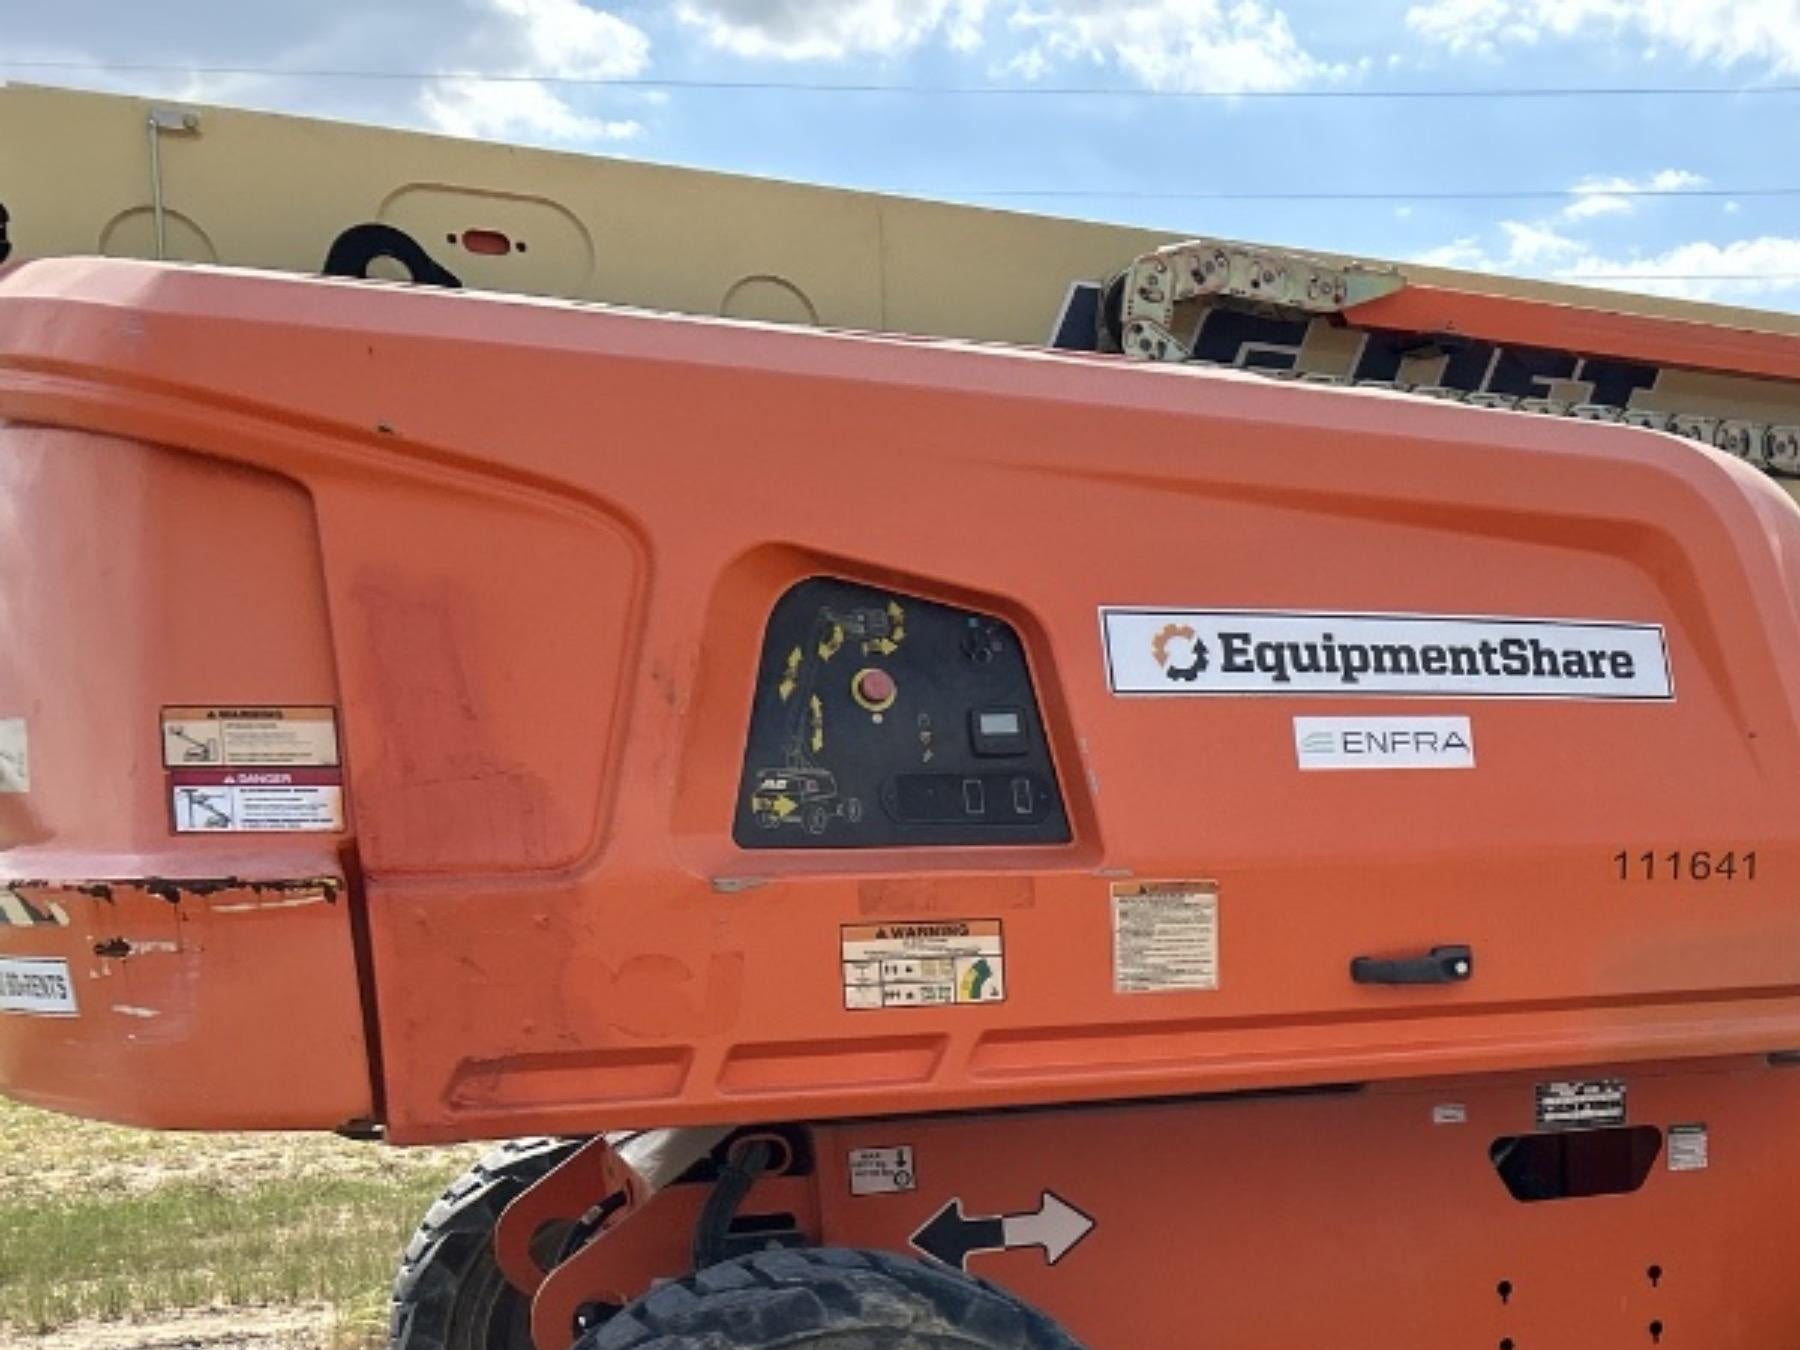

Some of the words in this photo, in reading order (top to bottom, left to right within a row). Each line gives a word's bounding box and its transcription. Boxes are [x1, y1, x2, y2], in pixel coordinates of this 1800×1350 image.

[1217, 631, 1636, 684] EquipmentShare
[1342, 729, 1471, 754] ENFRA
[1613, 850, 1758, 881] 111641
[892, 923, 970, 940] WARNING
